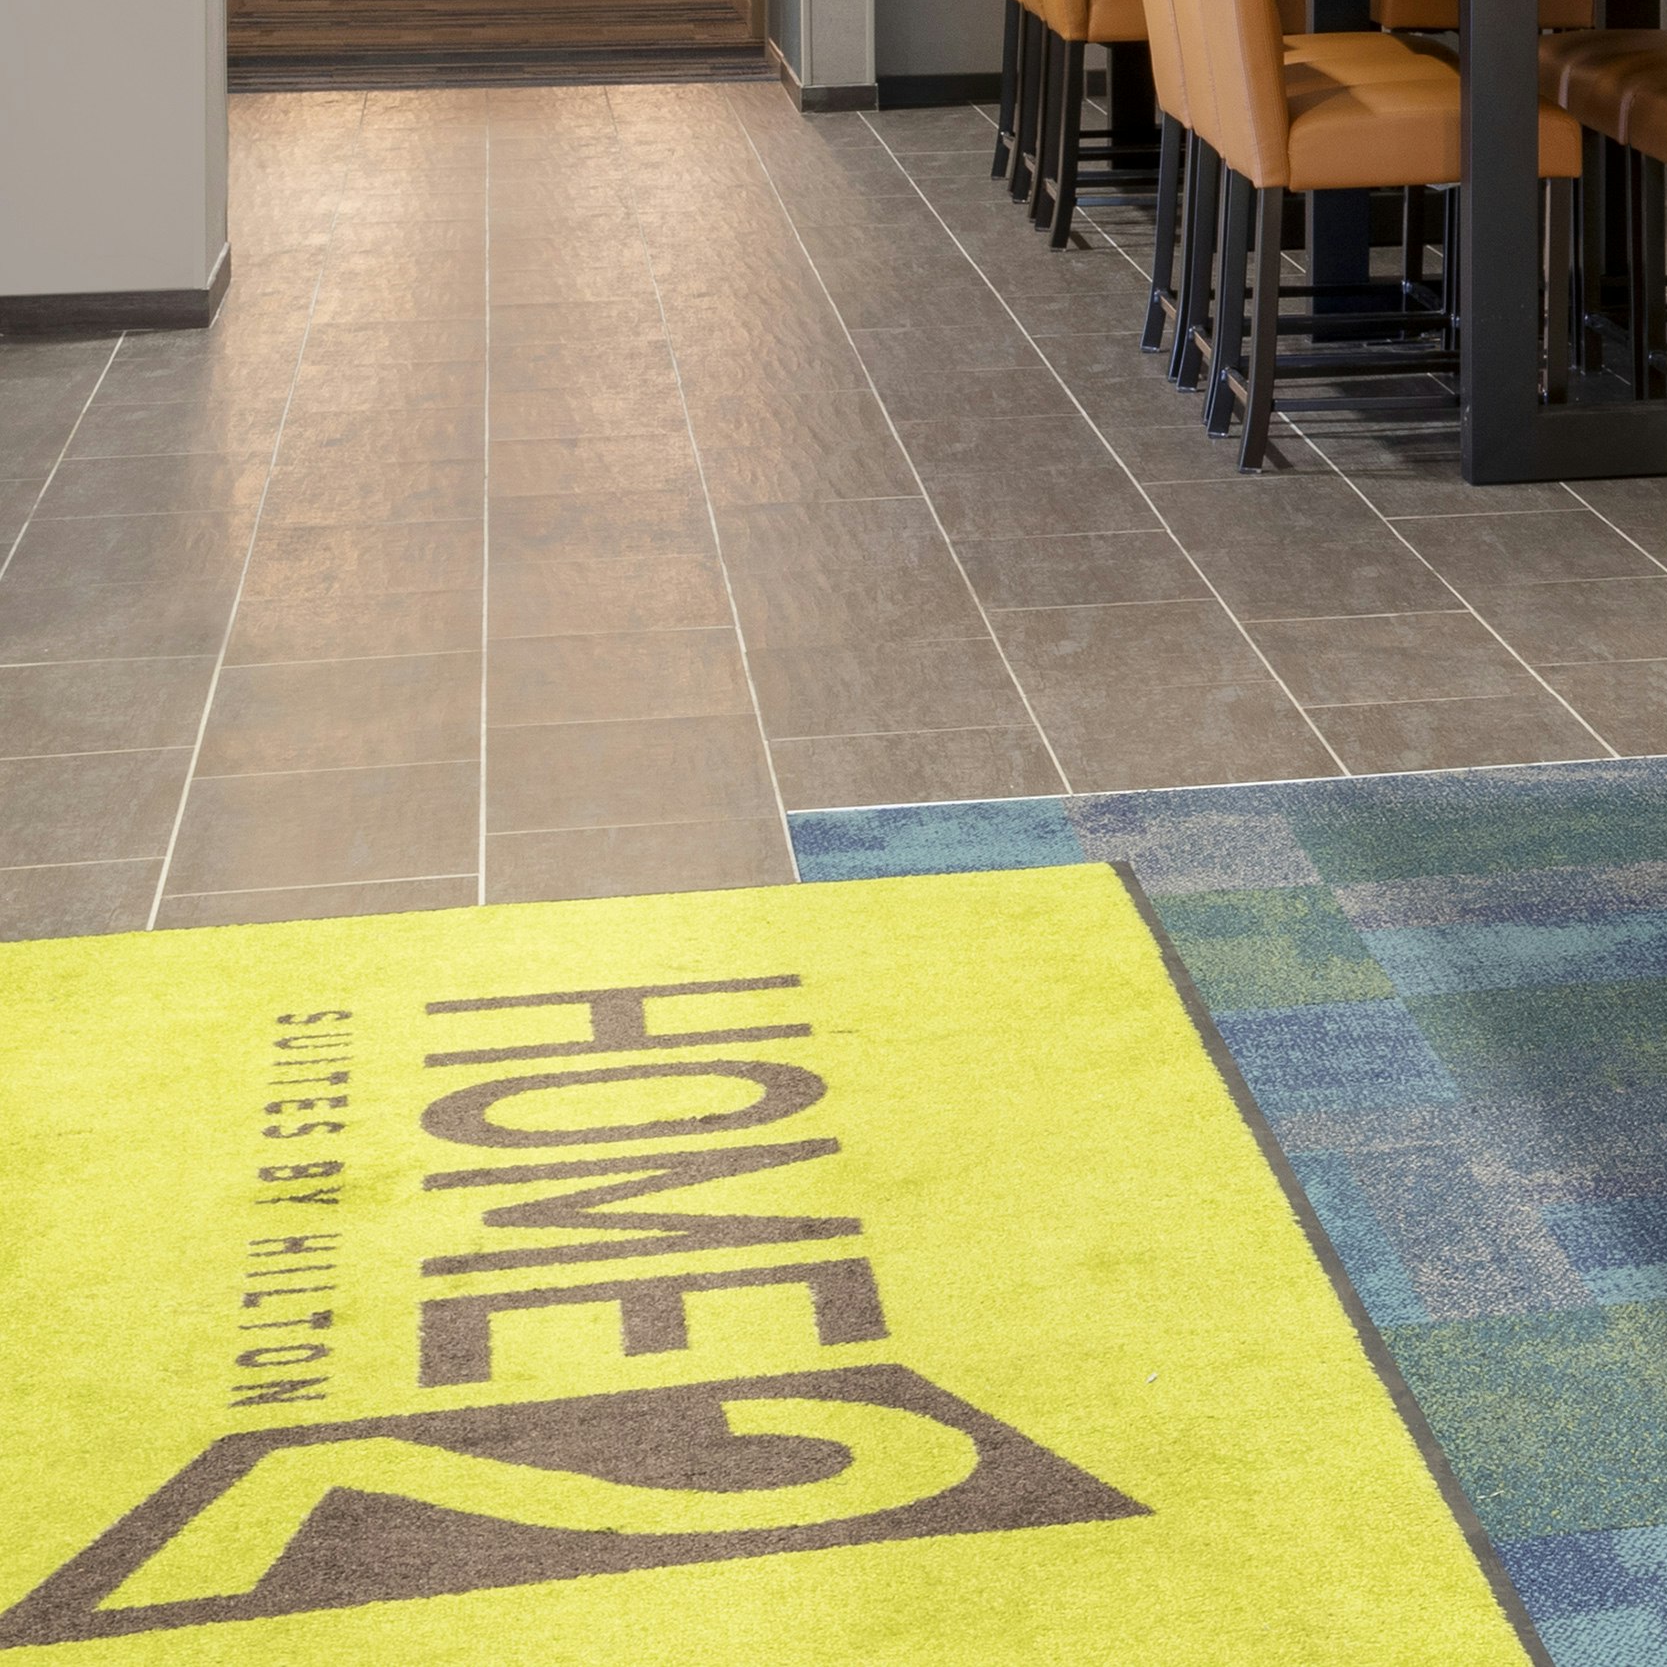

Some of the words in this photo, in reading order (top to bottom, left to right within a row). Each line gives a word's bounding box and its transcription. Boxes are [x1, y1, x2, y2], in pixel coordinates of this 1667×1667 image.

[260, 1010, 352, 1142] SUITES
[255, 1161, 343, 1210] BY
[230, 1231, 341, 1409] HILTON
